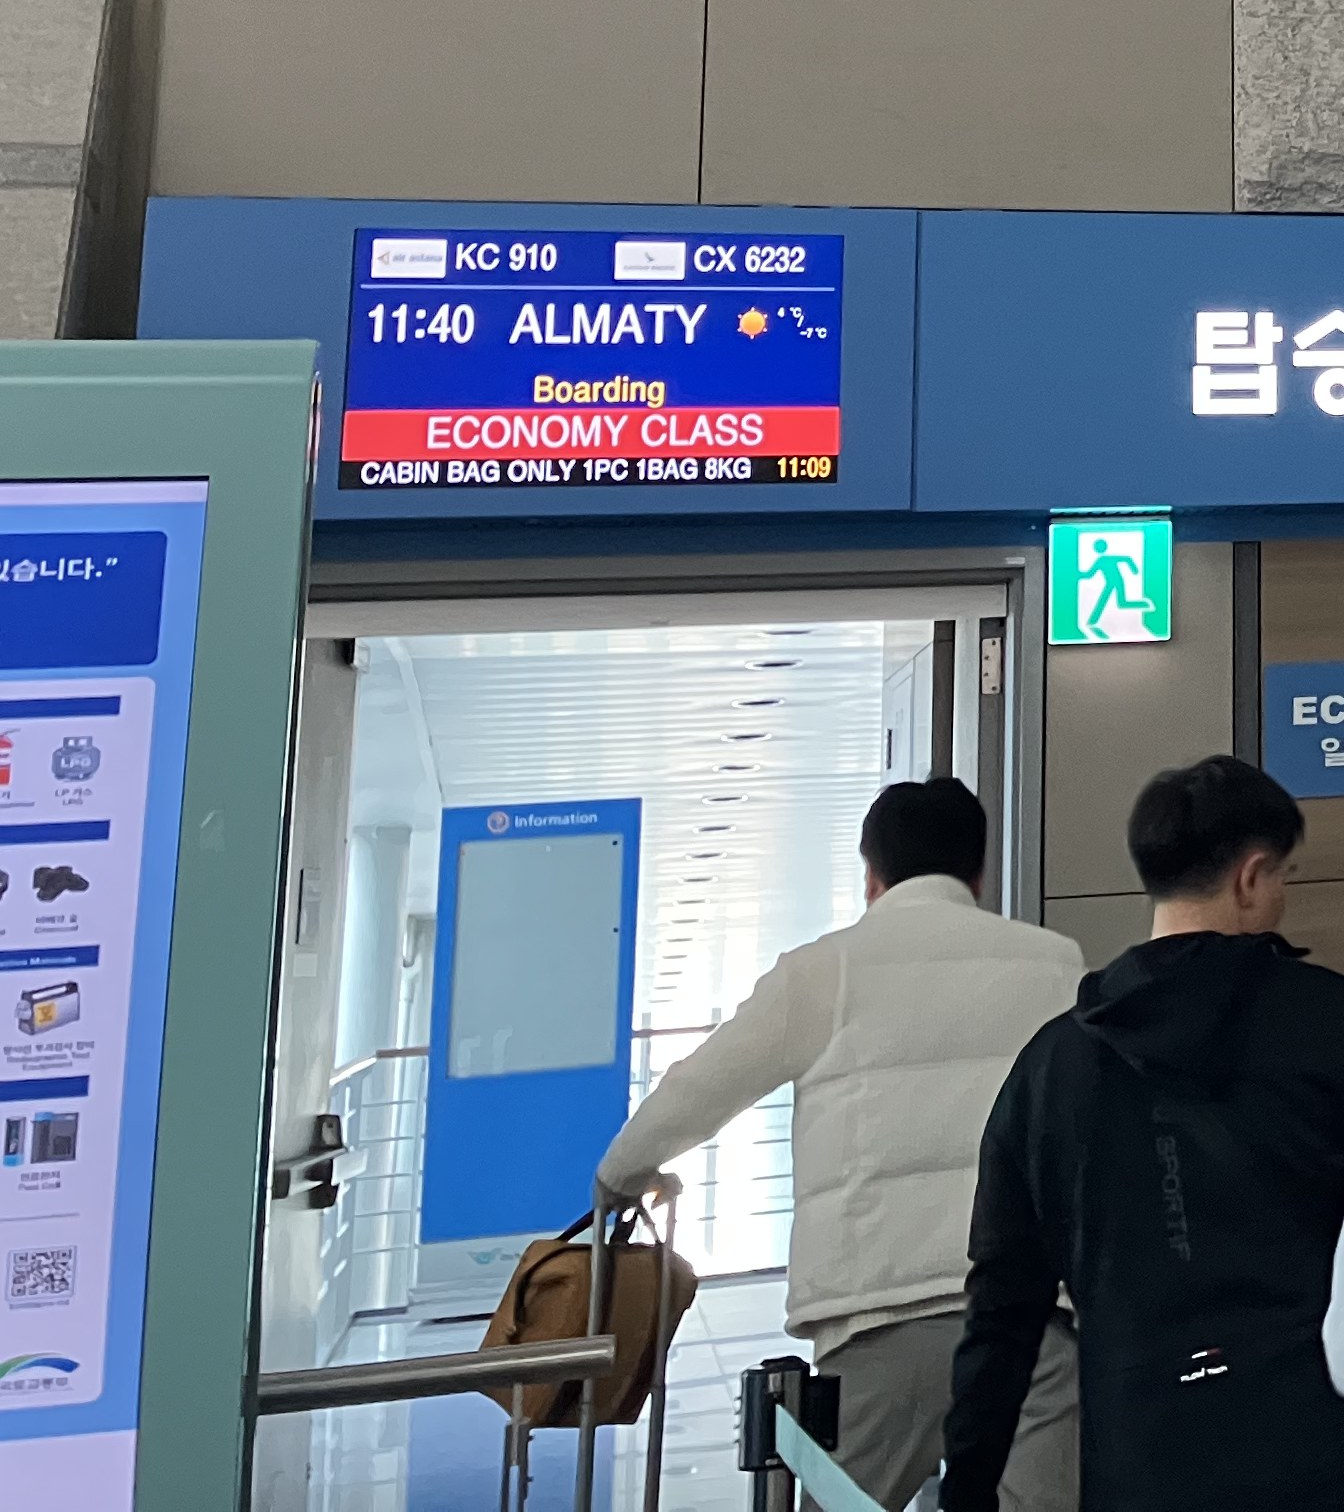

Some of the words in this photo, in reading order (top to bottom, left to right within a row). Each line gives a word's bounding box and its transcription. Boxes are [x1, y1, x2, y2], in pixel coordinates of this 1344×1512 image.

[455, 243, 500, 271] KC
[509, 243, 557, 272] 910
[694, 246, 738, 273] CX
[745, 246, 805, 274] 6232
[367, 303, 475, 344] 11:40
[509, 303, 706, 345] ALMATY
[533, 375, 665, 408] Boarding
[426, 414, 628, 449] ECONOMY
[640, 413, 764, 447] CLASS
[361, 461, 439, 485] CABIN
[447, 460, 500, 484] BAG
[507, 460, 576, 483] ONLY
[582, 459, 629, 482] 1PC
[636, 459, 698, 481] 1BAG
[704, 457, 752, 479] 8KG
[777, 456, 831, 478] 11:09
[514, 811, 598, 828] Information
